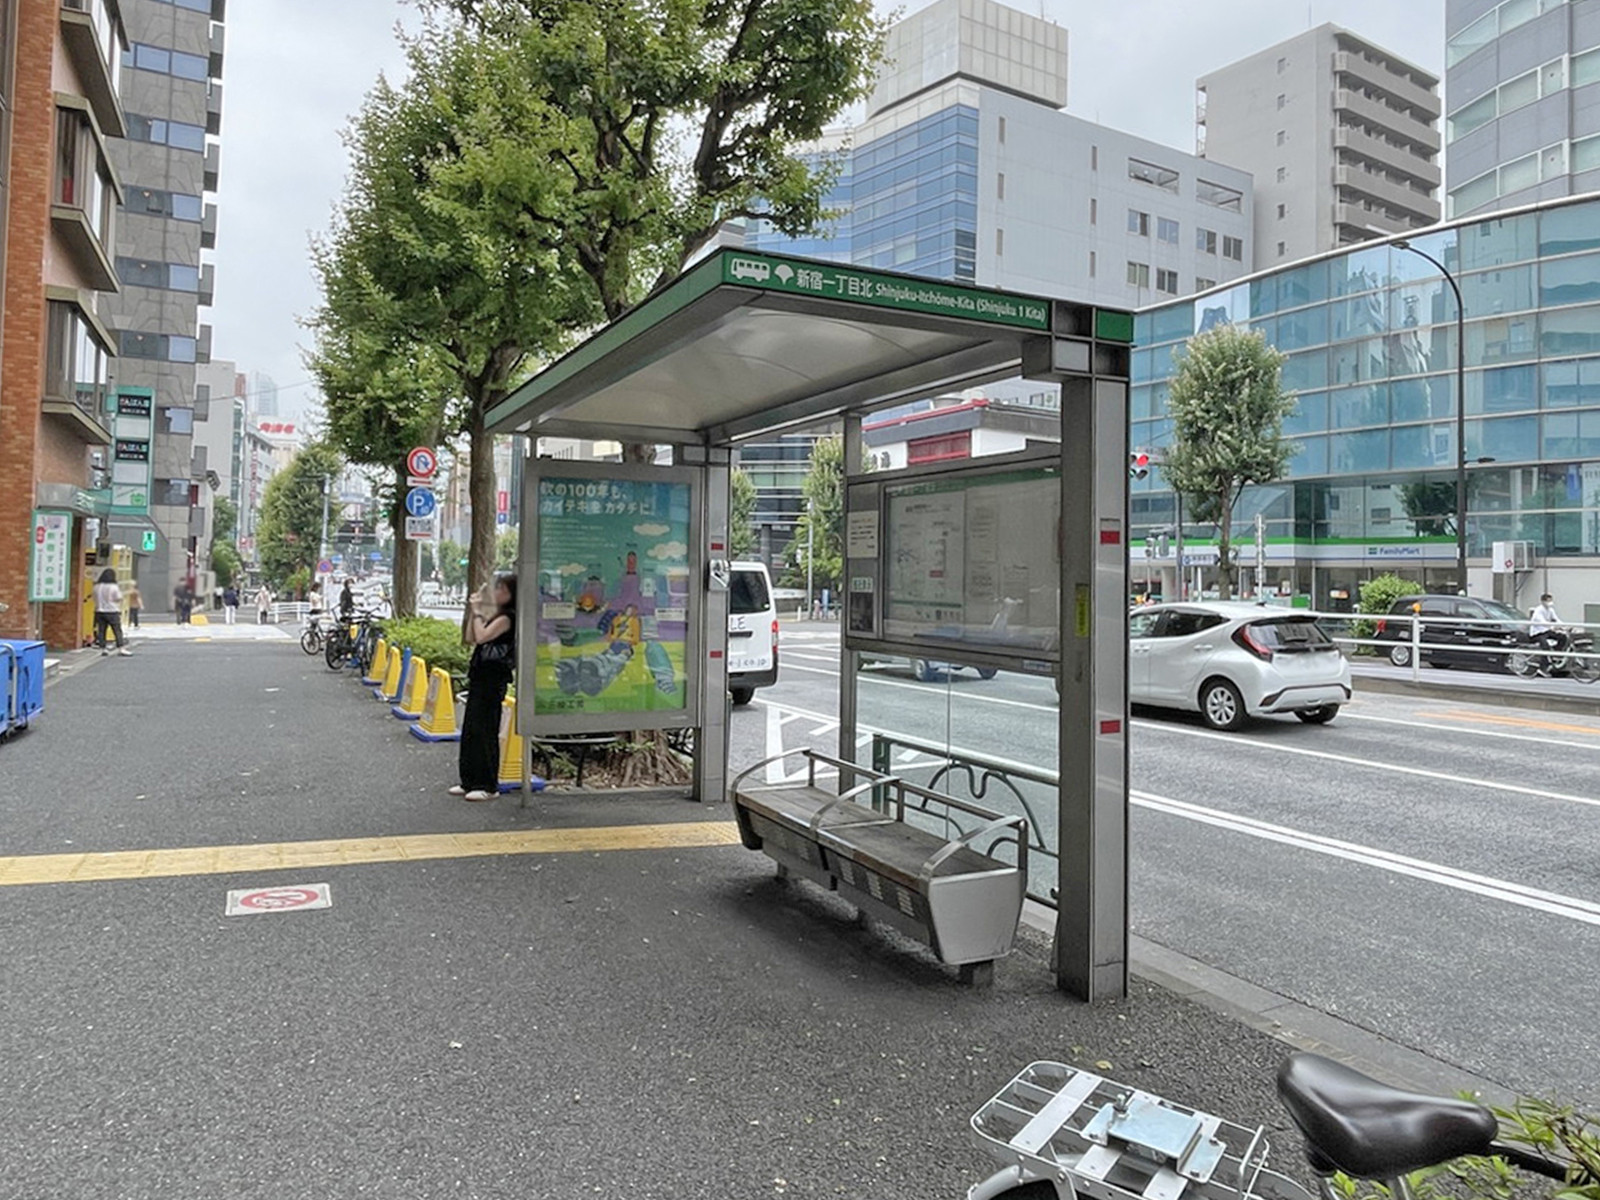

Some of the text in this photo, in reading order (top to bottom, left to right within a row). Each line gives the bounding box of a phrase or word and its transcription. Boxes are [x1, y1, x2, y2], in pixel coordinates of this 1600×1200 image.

[796, 269, 873, 298] 新宿一丁目北
[976, 298, 1017, 317] (Shinjuku
[1018, 305, 1023, 317] 1
[1025, 306, 1046, 322] Kita)
[413, 495, 425, 514] P
[1380, 546, 1419, 555] FamilyMart
